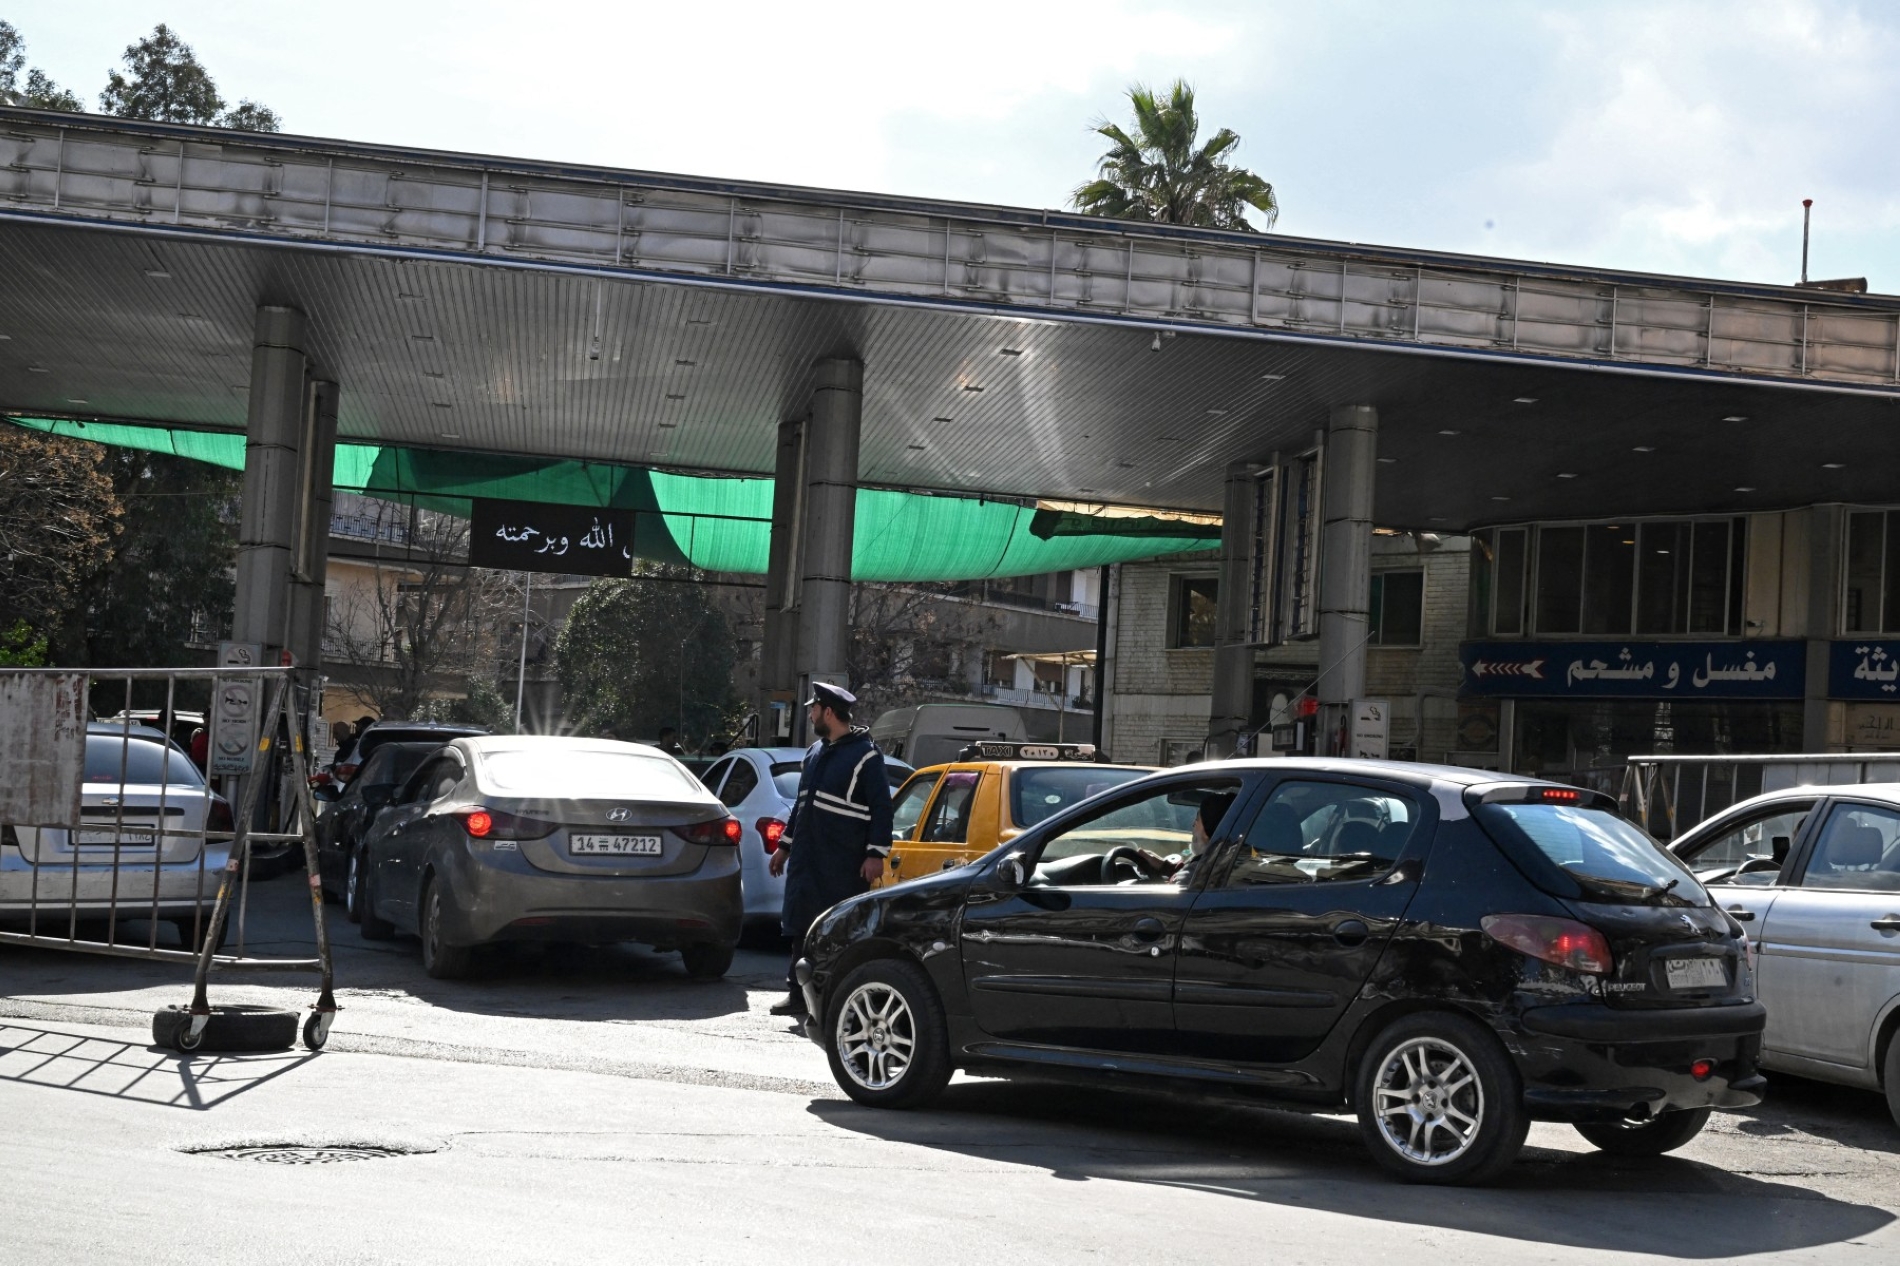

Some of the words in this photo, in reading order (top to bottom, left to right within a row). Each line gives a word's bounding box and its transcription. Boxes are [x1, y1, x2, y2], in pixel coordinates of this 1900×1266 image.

[495, 523, 569, 556] وبرحمته
[579, 517, 613, 549] الله
[1566, 646, 1654, 688] مشحم
[1660, 661, 1680, 689] و
[1692, 650, 1776, 688] مغسل
[981, 745, 1014, 758] TAXI
[577, 836, 595, 851] 14
[613, 838, 657, 852] 47212
[1607, 982, 1647, 992] PEUGEOT
